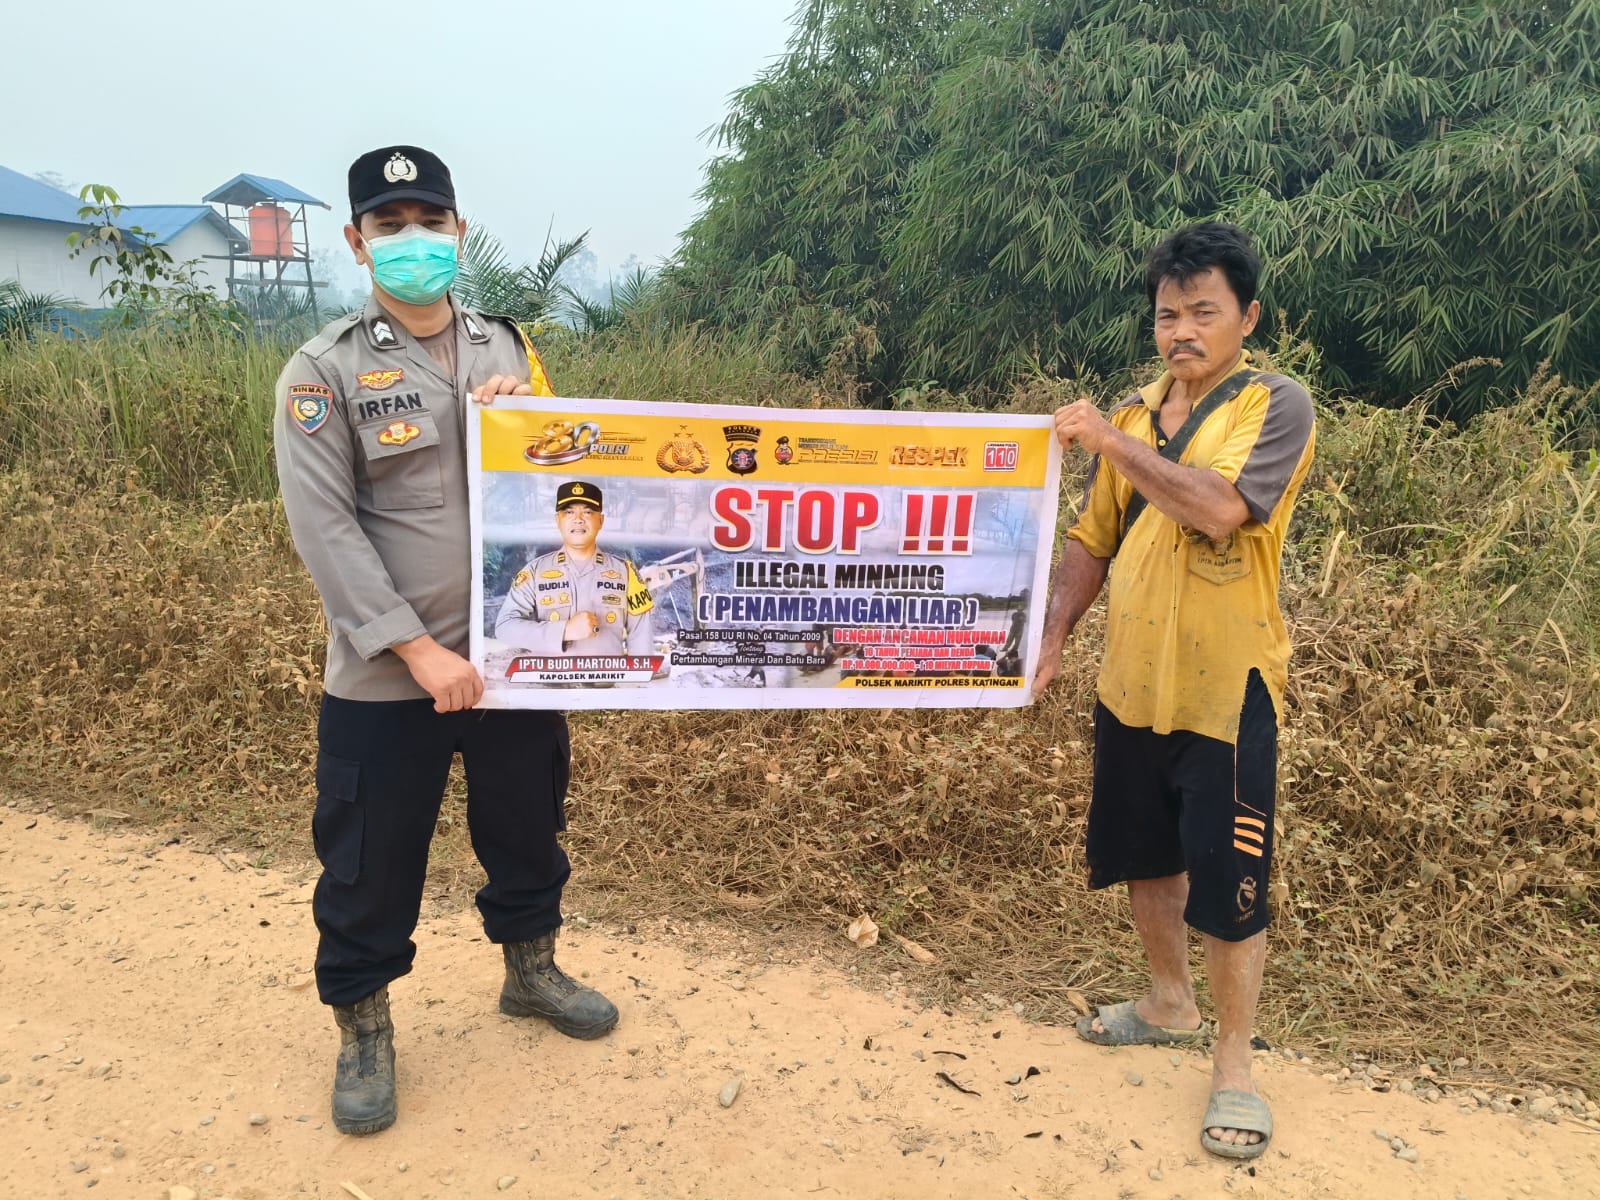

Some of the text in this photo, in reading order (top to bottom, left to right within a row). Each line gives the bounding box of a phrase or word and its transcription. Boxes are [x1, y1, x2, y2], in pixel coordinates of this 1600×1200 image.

[292, 386, 329, 395] BINMAS
[358, 392, 423, 420] IRFAN
[589, 443, 629, 455] POLRI
[889, 446, 968, 467] RESPEK
[987, 449, 1015, 465] 110
[712, 485, 974, 553] STOP !!!
[735, 561, 945, 590] ILLEGAL MINNING
[596, 581, 626, 592] POLRI
[627, 589, 652, 611] KAPO
[715, 596, 902, 623] PENAMBANGAN
[908, 598, 962, 624] LIAR
[679, 631, 821, 641] Pasal 158 UU RI No. 04 Tahun 2009
[833, 629, 1006, 645] DENGAN ANCAMAN HUKUMAN
[518, 659, 543, 670] IPTU
[547, 659, 573, 670] BUDI
[577, 659, 630, 671] HARTONO,
[673, 655, 826, 666] Pertambangan Mineral Dan Batu Bara
[539, 673, 586, 681] KAPOLSEK
[855, 678, 1019, 687] POLSEK MARIKIT POLRES KATINGAN
